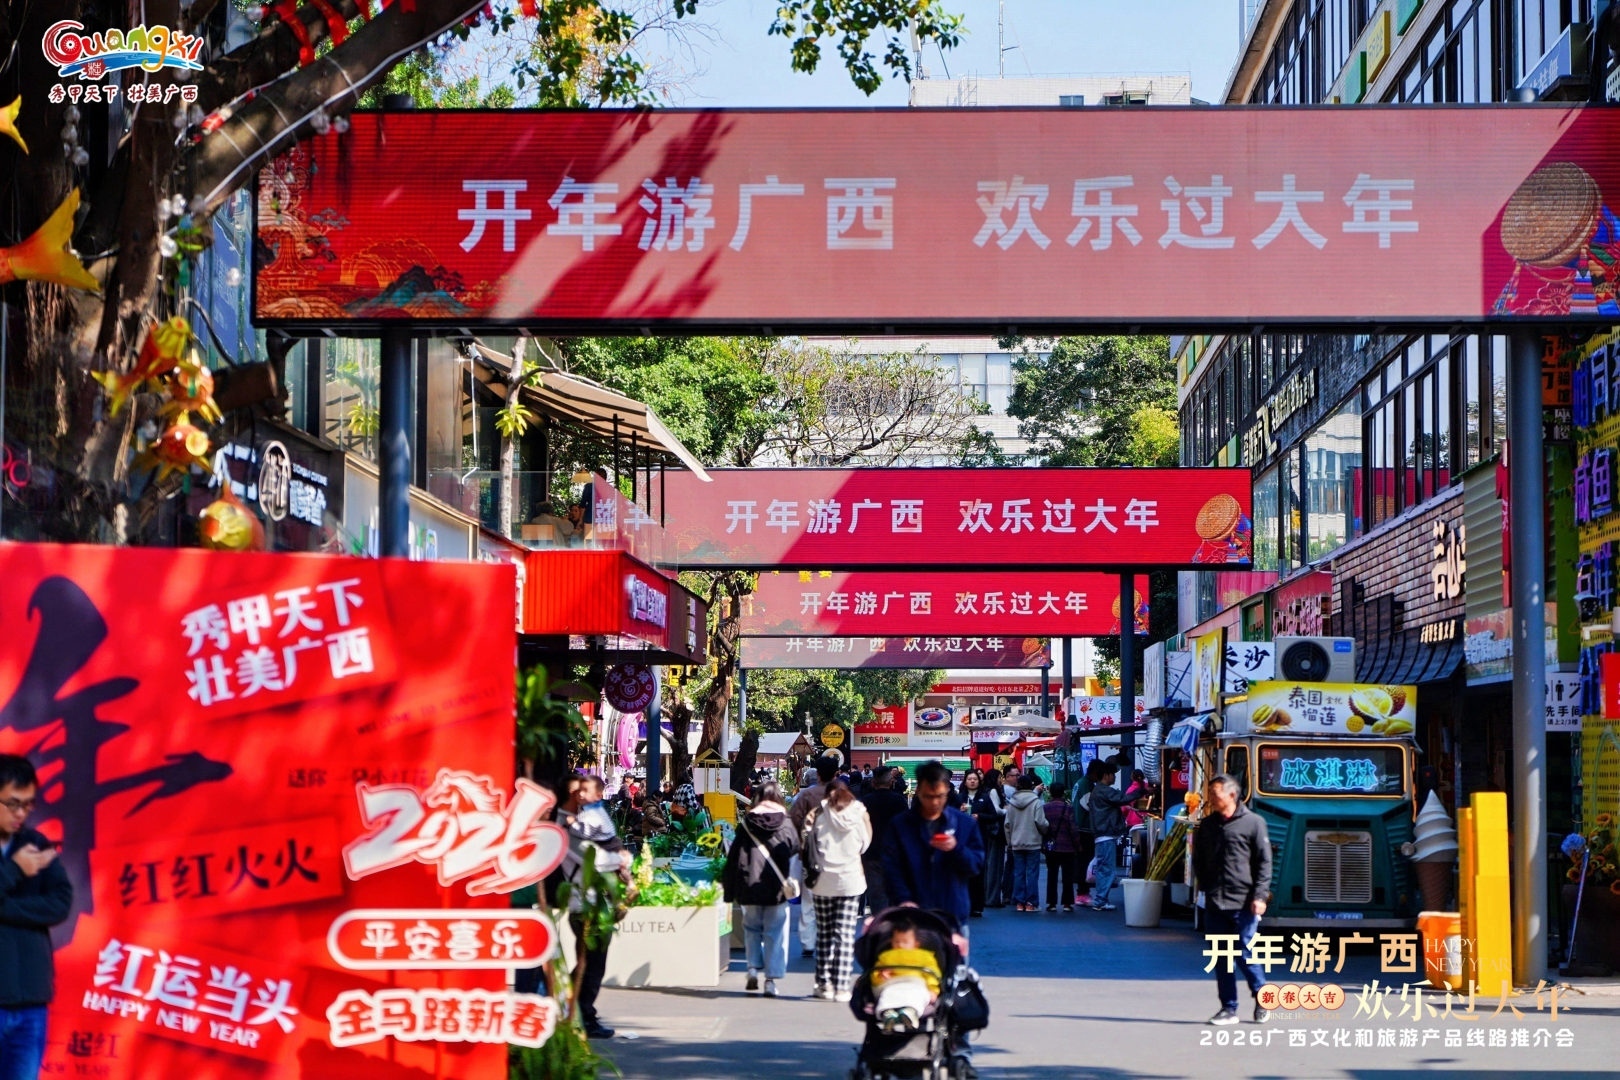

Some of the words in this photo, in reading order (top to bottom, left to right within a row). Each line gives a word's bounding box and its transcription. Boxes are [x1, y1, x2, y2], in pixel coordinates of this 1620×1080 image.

[457, 175, 897, 252] 开年游广西
[972, 173, 1419, 252] 欢乐过大年
[724, 498, 925, 534] 开年游广西
[957, 498, 1160, 534] 欢乐过大年
[181, 577, 364, 656] 秀甲天下
[800, 591, 931, 616] 开年游广西
[954, 591, 1088, 616] 欢乐过大年
[786, 637, 886, 653] 开年游广西
[902, 637, 1005, 653] 欢乐过大年
[184, 627, 374, 706] 壮美广西
[1288, 685, 1322, 709] 泰国
[1302, 706, 1337, 726] 榴莲
[860, 735, 891, 745] 前方50米
[1281, 758, 1377, 789] 冰淇淋
[343, 777, 569, 896] 2026
[118, 838, 321, 907] 红红火火
[361, 920, 525, 962] 平安喜乐
[648, 921, 677, 933] TEA
[92, 938, 298, 1033] 红运当头
[83, 992, 148, 1022] HAPPY
[156, 1009, 200, 1035] NEW
[209, 1021, 260, 1049] YEAR
